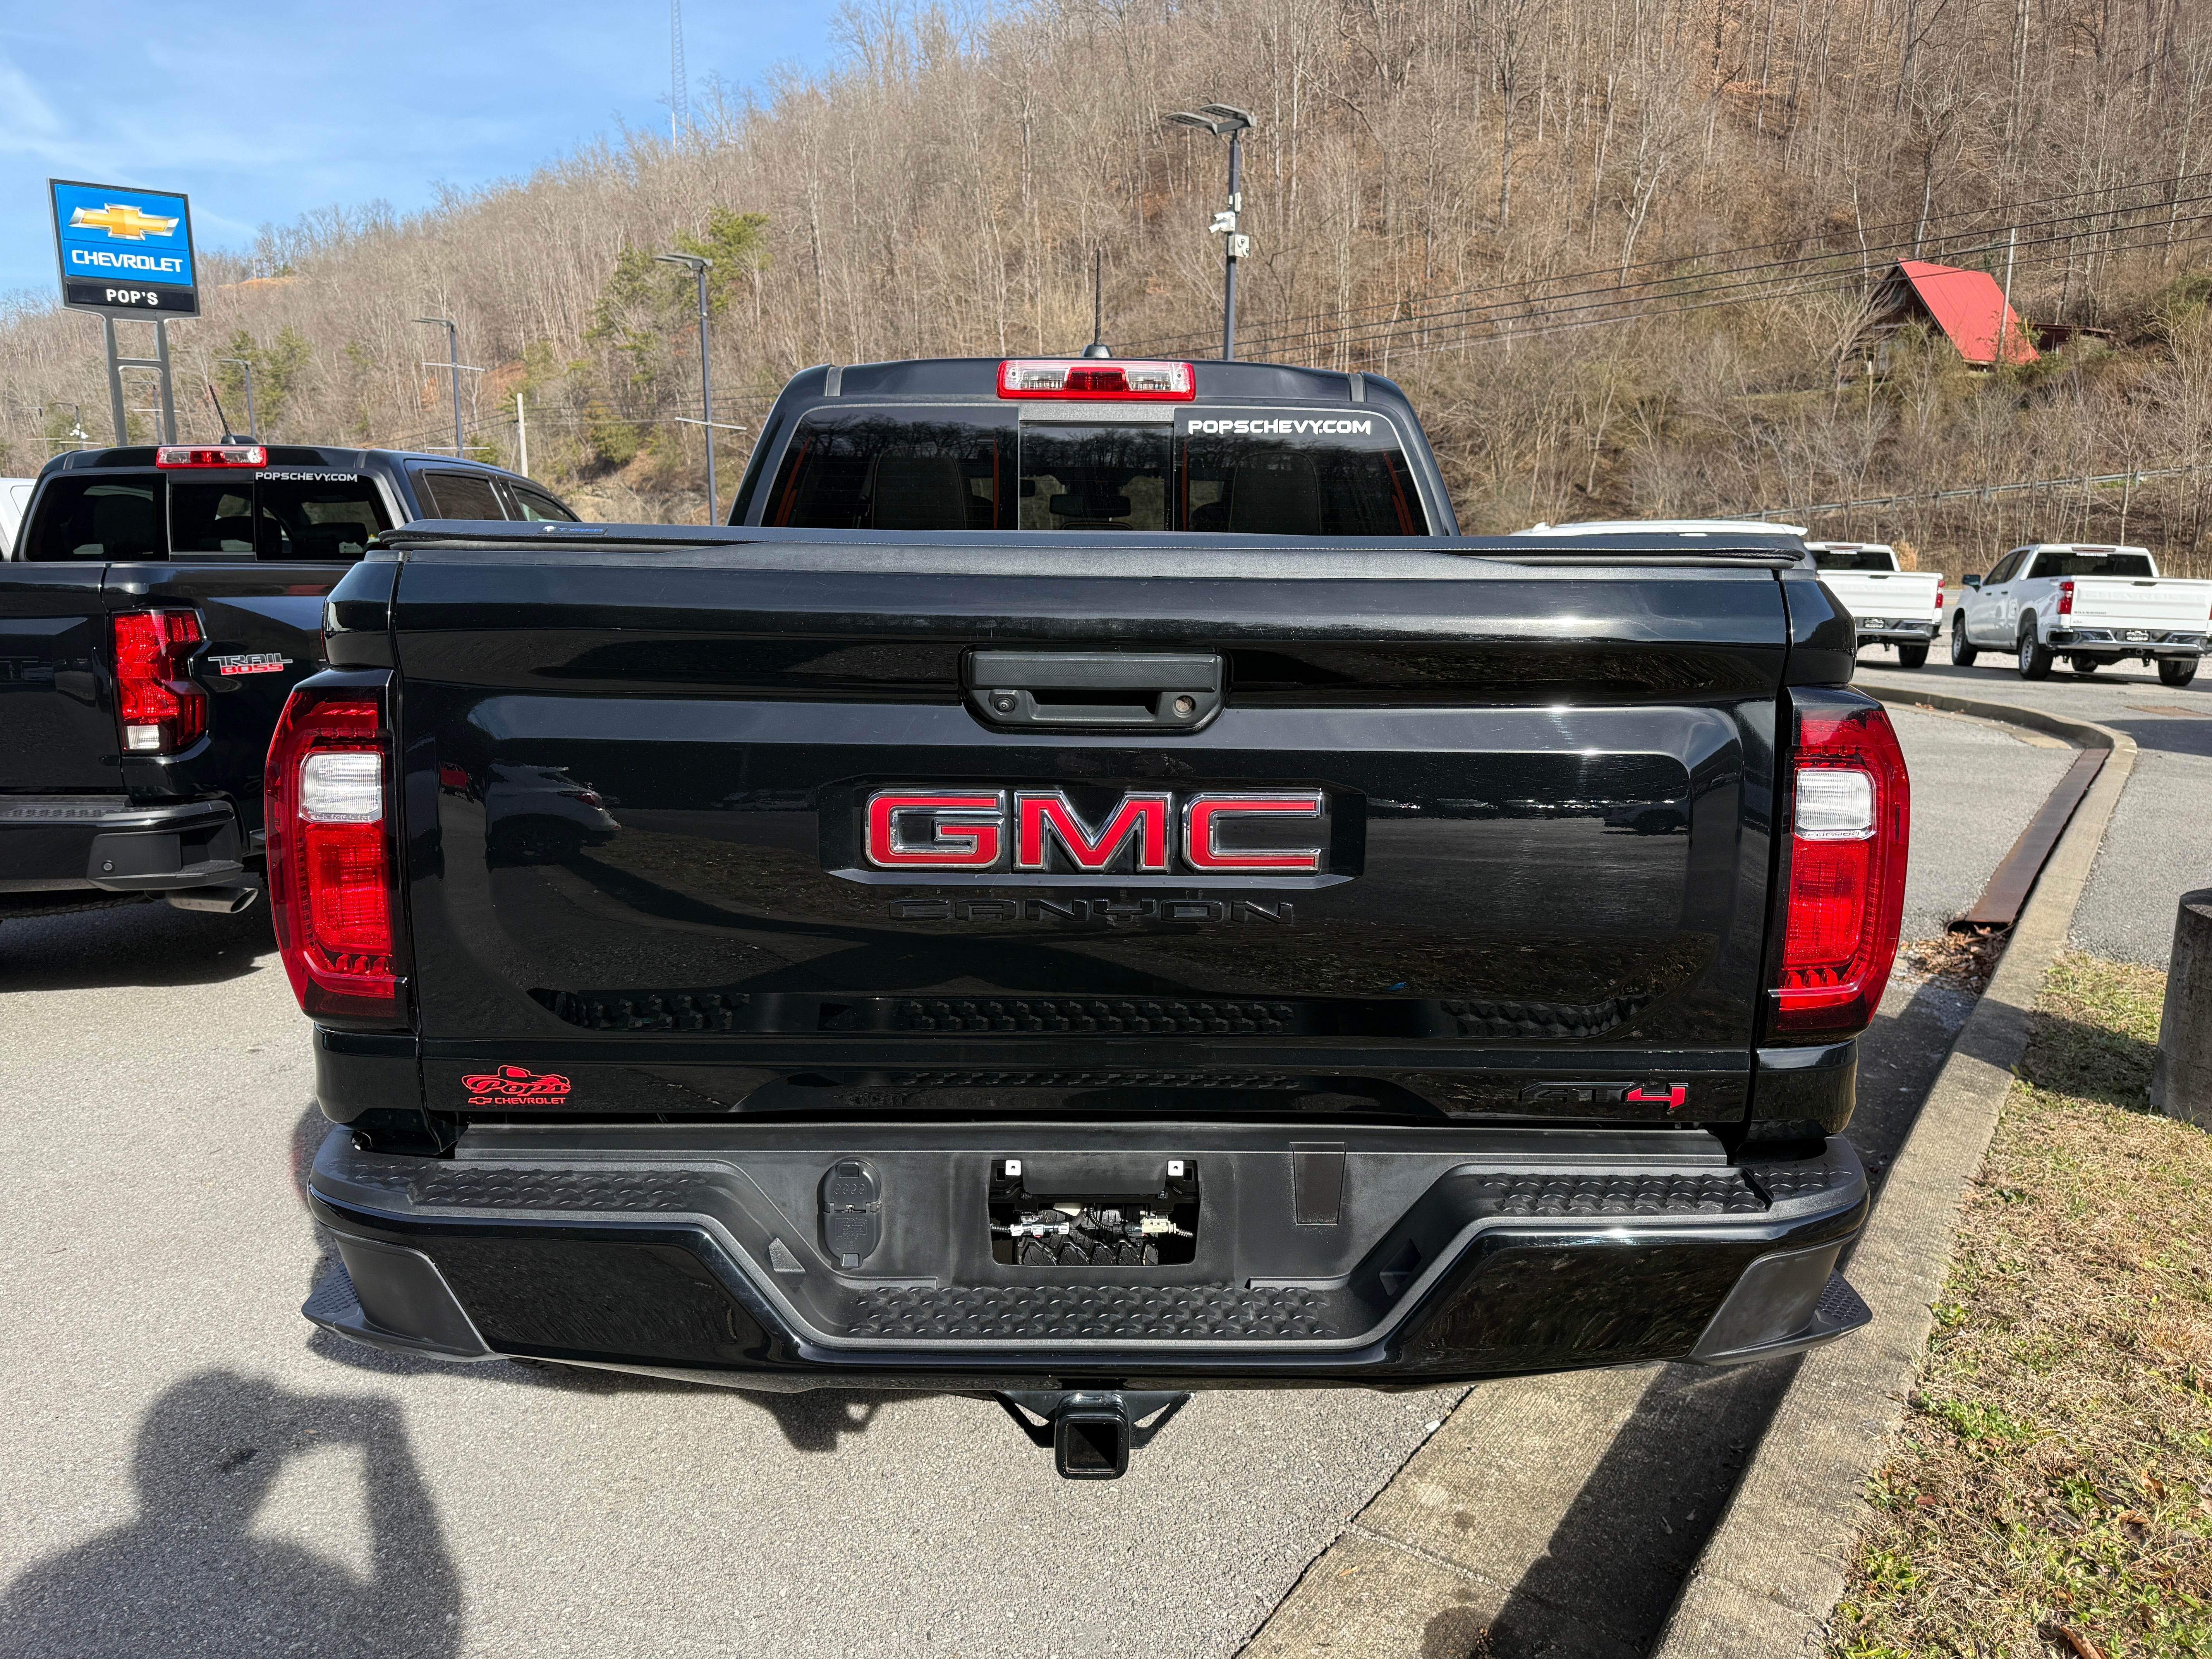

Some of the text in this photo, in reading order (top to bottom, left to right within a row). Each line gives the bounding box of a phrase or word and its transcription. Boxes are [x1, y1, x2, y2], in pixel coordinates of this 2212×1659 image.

[72, 250, 183, 272] CHEVROLET
[106, 289, 158, 305] POP'S
[1187, 418, 1371, 435] POPSCHEVY.COM
[255, 472, 358, 483] POPSCHEVY.COM
[208, 653, 294, 666] TRAIL
[221, 663, 284, 675] BOSS
[864, 787, 1323, 873] GMC
[888, 898, 1294, 924] CANYON
[1520, 1081, 1690, 1111] AT4
